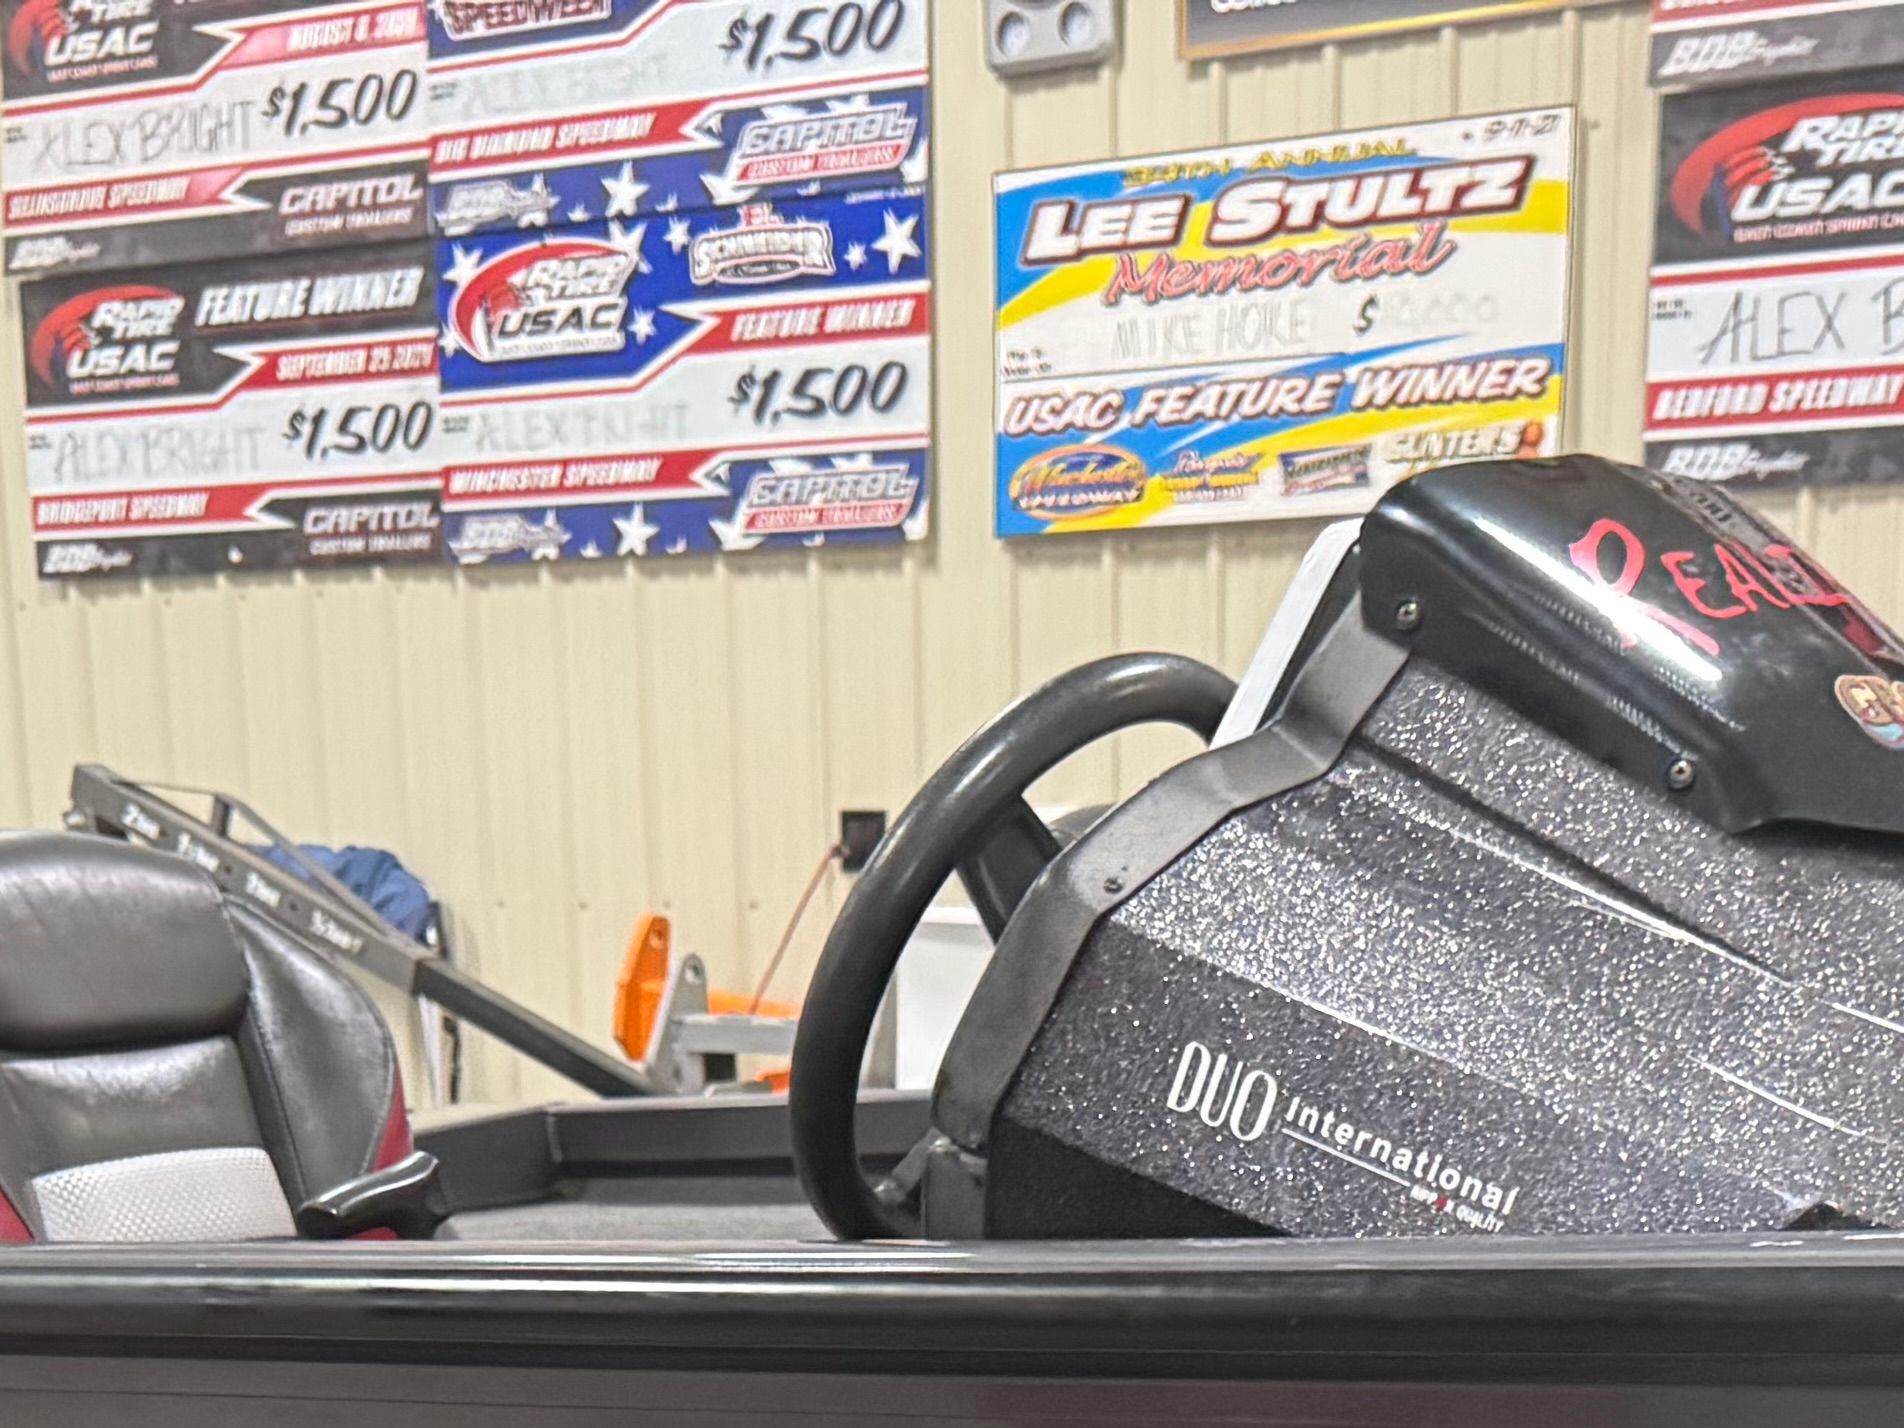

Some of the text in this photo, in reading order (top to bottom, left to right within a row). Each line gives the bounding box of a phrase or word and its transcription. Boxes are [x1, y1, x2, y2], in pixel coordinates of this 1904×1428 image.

[45, 19, 159, 66] USAC
[720, 0, 907, 71] $1,500
[262, 69, 417, 137] $1,500
[743, 105, 911, 156] CAPITOL
[280, 174, 424, 215] CAPITOL
[1022, 154, 1536, 265] LEE STULTZ
[1103, 221, 1458, 305] Memorial
[195, 268, 424, 327] FEATURE WINNER
[499, 302, 621, 338] USAC
[730, 298, 917, 342] FEATURE WINNER
[1697, 290, 1846, 365] ALEX
[67, 340, 180, 378] USAC
[728, 360, 908, 427] $1,500
[1004, 358, 1551, 437] USAC FEATURE WINNER
[1652, 382, 1769, 421] BEDFORD
[283, 401, 433, 461] $1,500
[750, 467, 912, 506] CAPITOL
[303, 502, 438, 533] CAPITOL
[1167, 1041, 1520, 1216] DUO International
